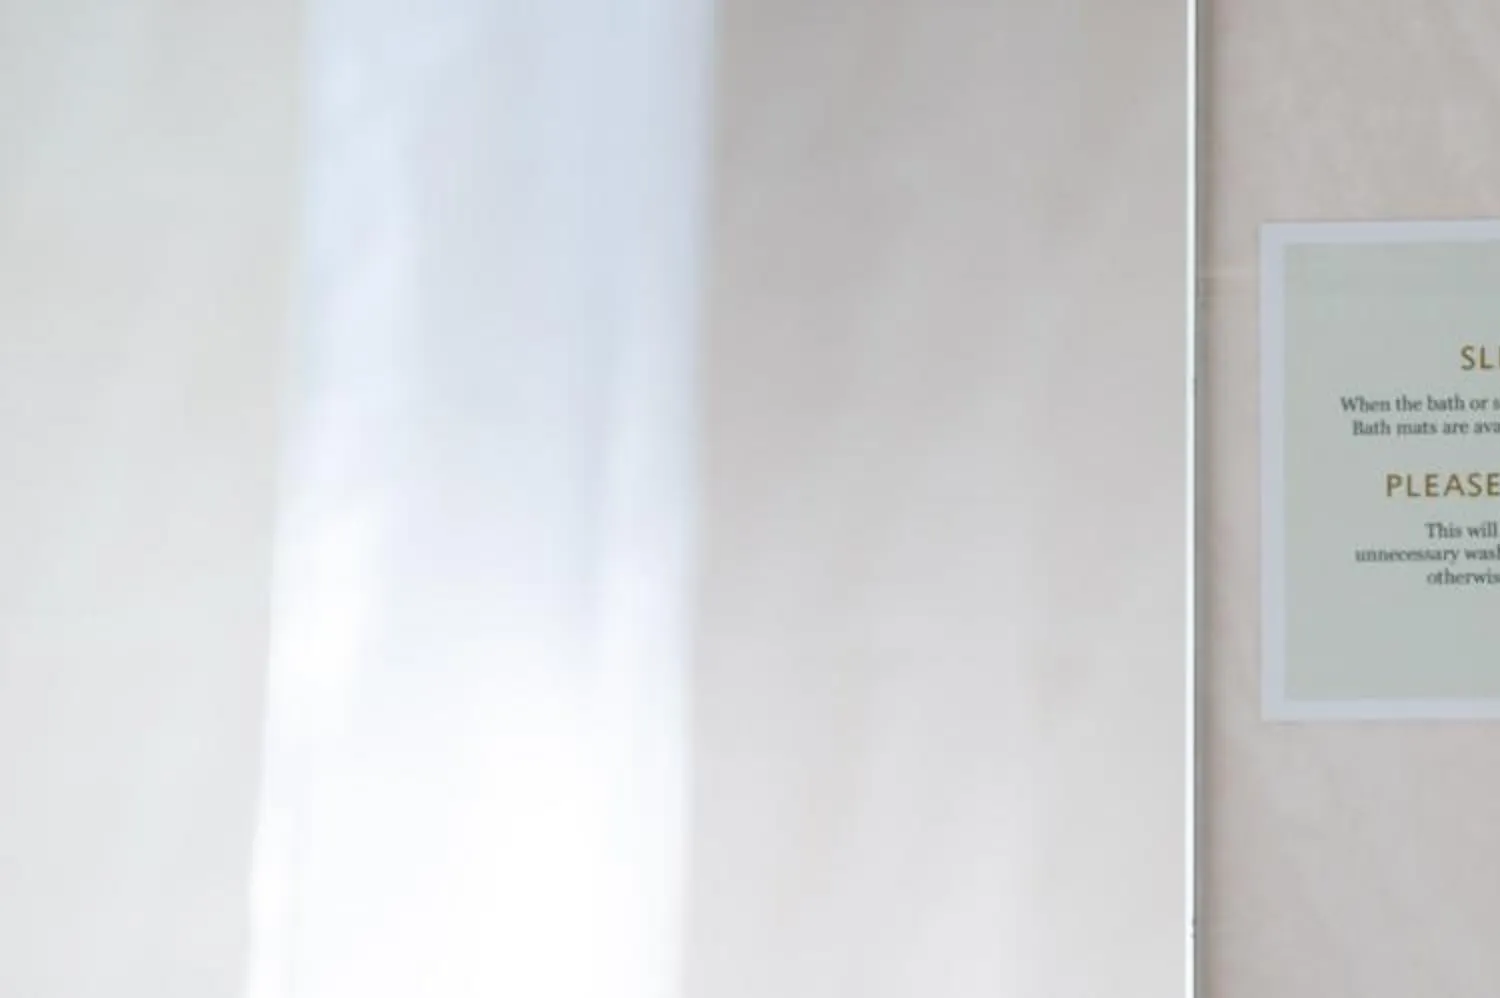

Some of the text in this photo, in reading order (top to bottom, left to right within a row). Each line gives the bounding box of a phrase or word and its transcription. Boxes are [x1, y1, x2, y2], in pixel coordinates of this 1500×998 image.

[1341, 395, 1391, 413] When
[1396, 395, 1422, 412] the
[1427, 393, 1465, 413] bath
[1469, 399, 1489, 412] or
[1353, 419, 1391, 436] Bath
[1397, 422, 1438, 435] mats
[1442, 421, 1469, 435] are
[1387, 472, 1500, 499] PLEASE
[1424, 522, 1462, 539] This
[1467, 521, 1498, 538] will
[1355, 549, 1459, 565] unnecessary
